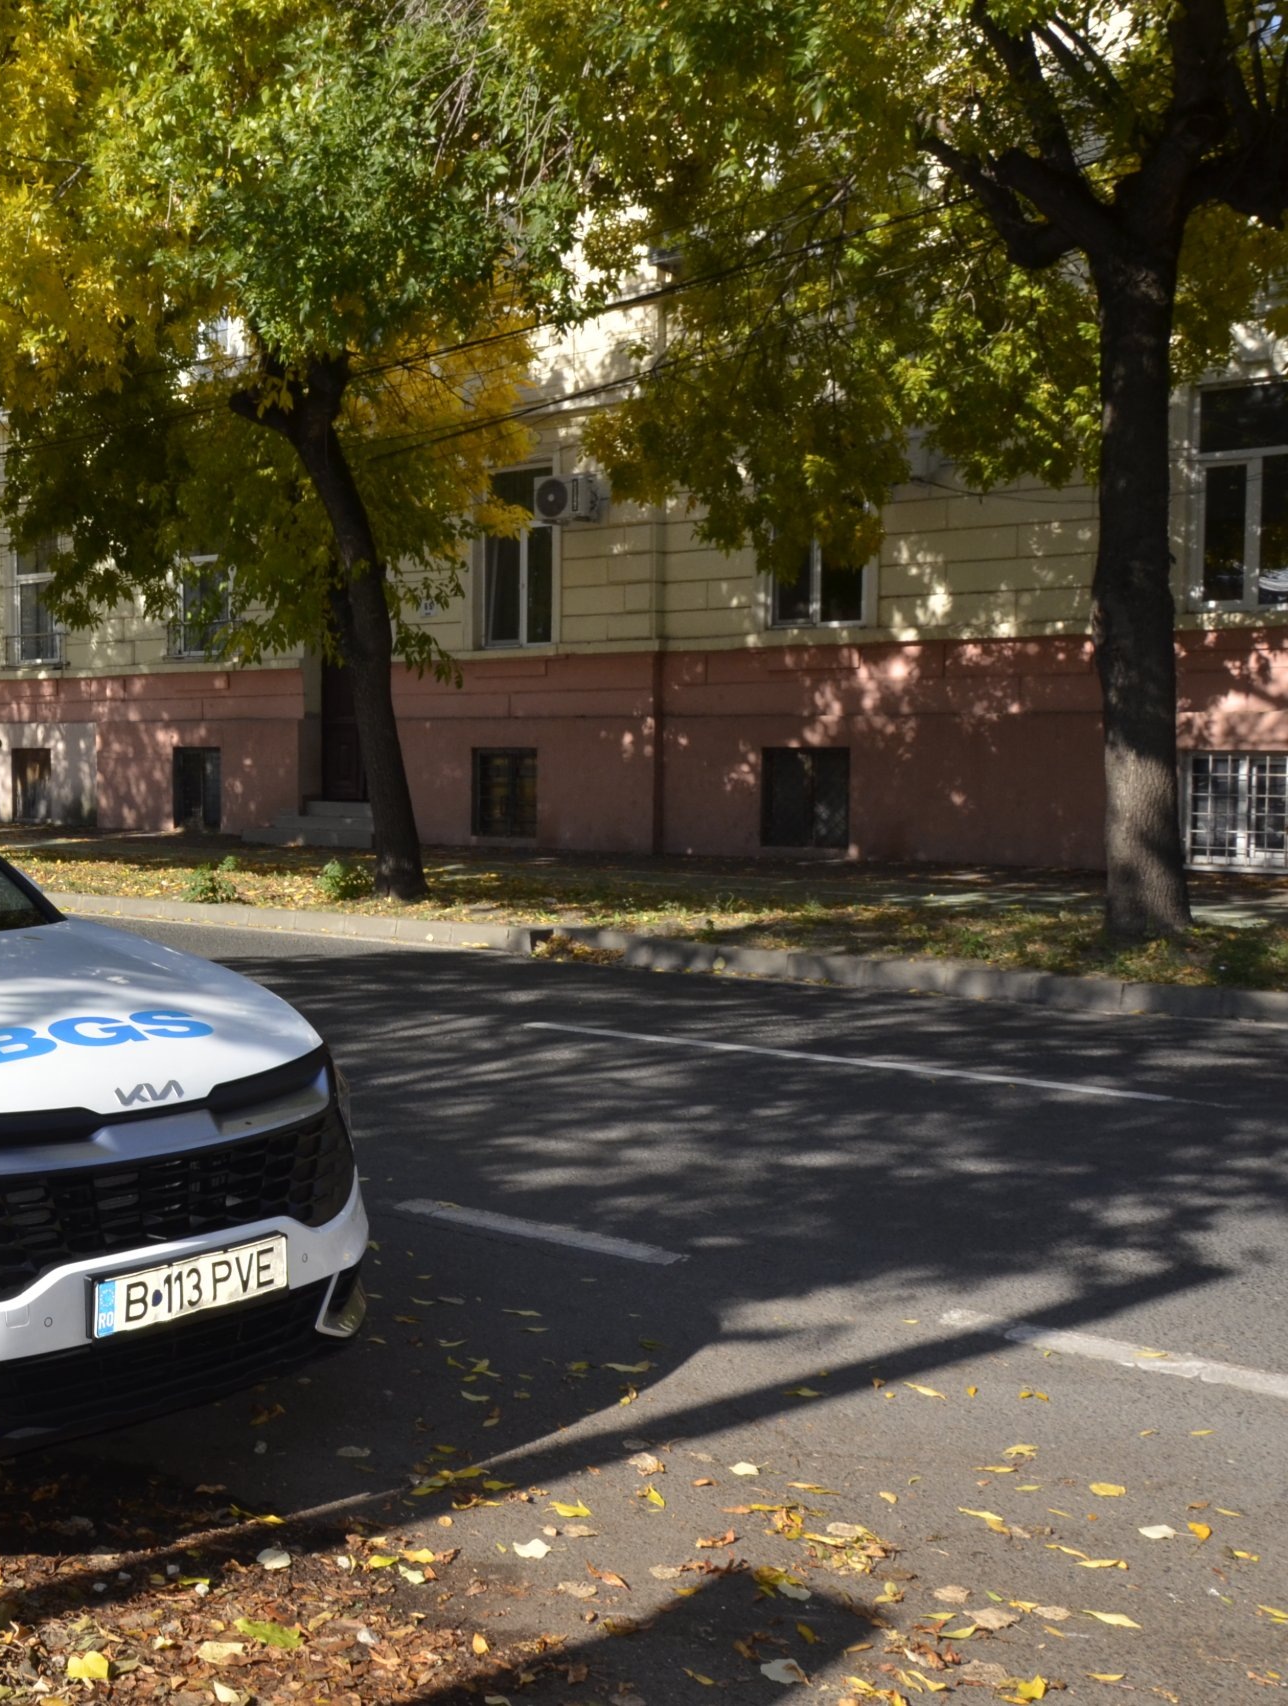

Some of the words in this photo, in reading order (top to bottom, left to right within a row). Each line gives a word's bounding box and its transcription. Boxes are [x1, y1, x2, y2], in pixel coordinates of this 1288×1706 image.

[114, 1079, 185, 1107] KIA
[211, 1246, 274, 1302] PVE
[98, 1311, 114, 1329] RO
